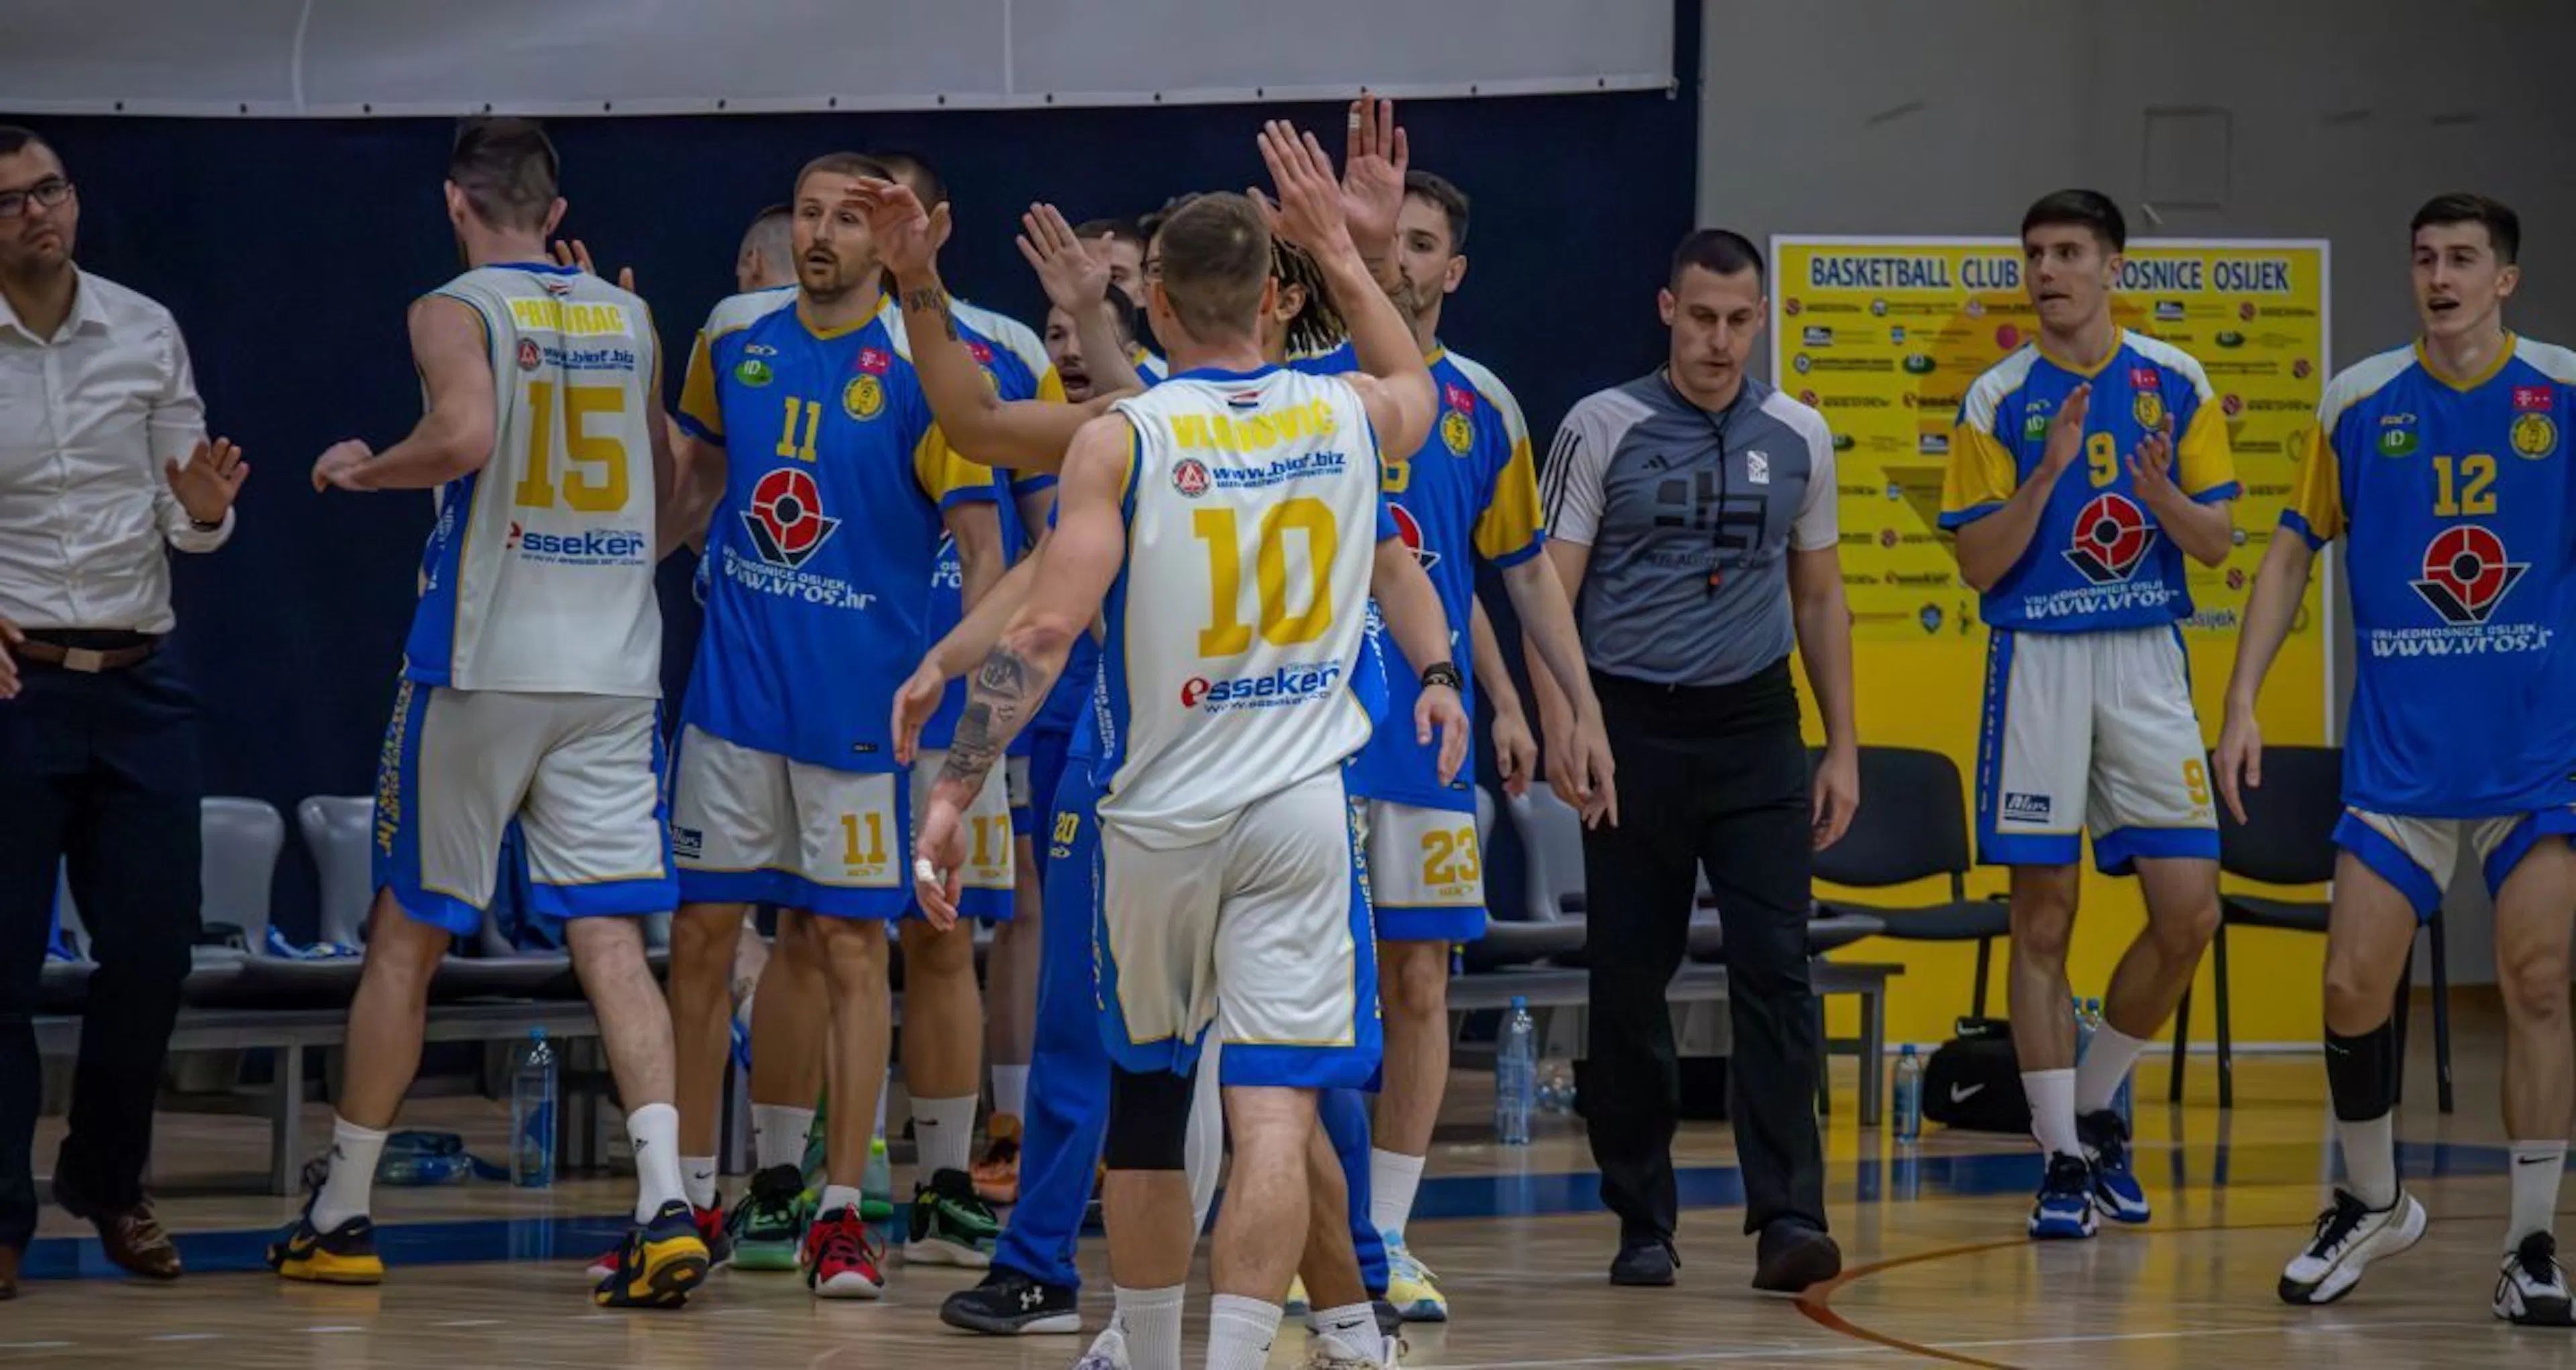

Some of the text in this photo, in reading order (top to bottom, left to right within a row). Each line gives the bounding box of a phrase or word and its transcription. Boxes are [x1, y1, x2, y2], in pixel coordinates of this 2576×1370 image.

[1811, 257, 2290, 291] BASKETBALL CLUB OSNICE OSIJEK
[515, 381, 629, 512] 15
[776, 397, 821, 462] 11
[2087, 432, 2118, 488] 9
[2432, 454, 2497, 517] 12
[1193, 497, 1336, 657] 10
[2182, 758, 2210, 804] 9
[841, 811, 888, 865] 11
[1053, 811, 1079, 844] 20
[1420, 825, 1480, 885] 23
